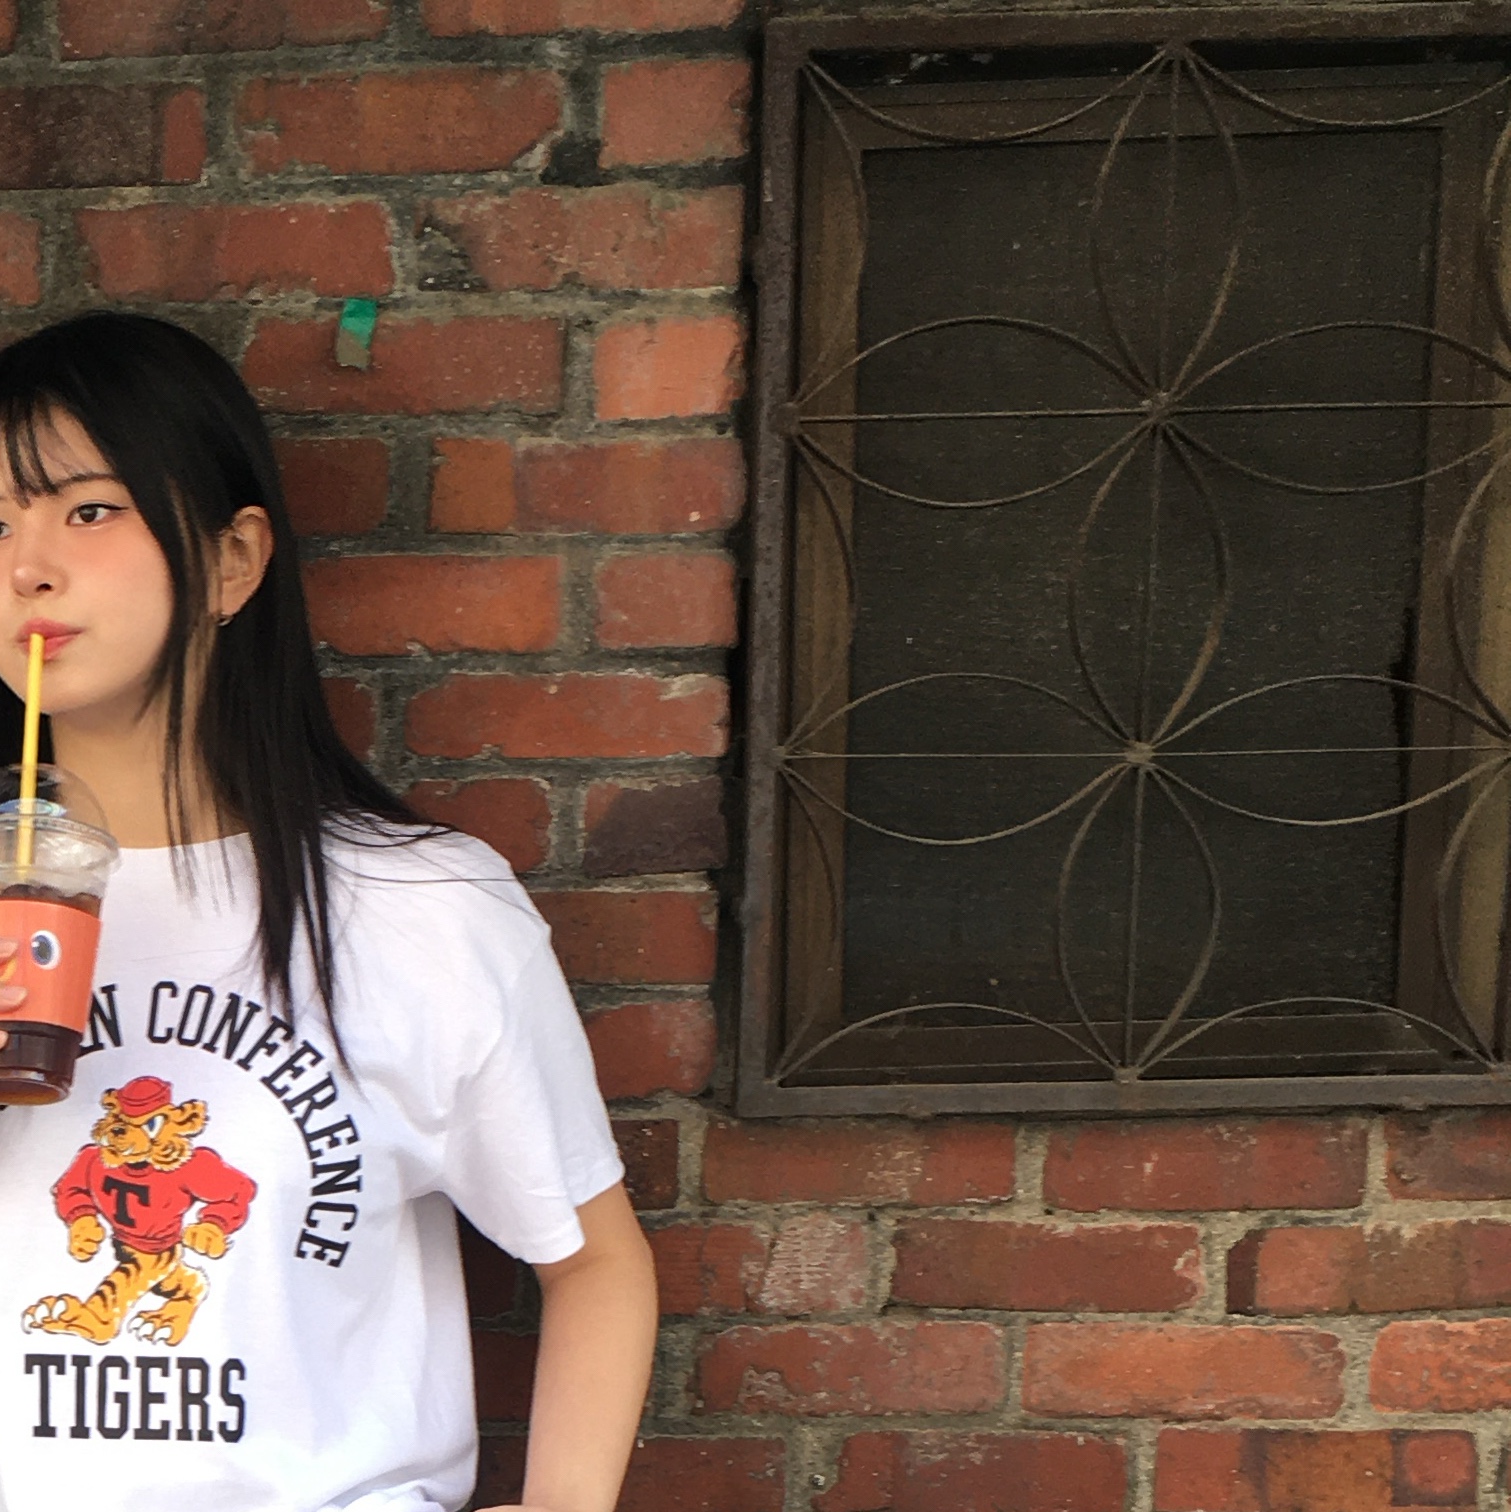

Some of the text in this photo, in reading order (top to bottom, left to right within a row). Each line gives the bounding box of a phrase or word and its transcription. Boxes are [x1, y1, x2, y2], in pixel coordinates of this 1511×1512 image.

[147, 981, 362, 1268] CONFERENCE
[102, 1175, 150, 1228] T
[24, 1353, 247, 1443] TIGERS
